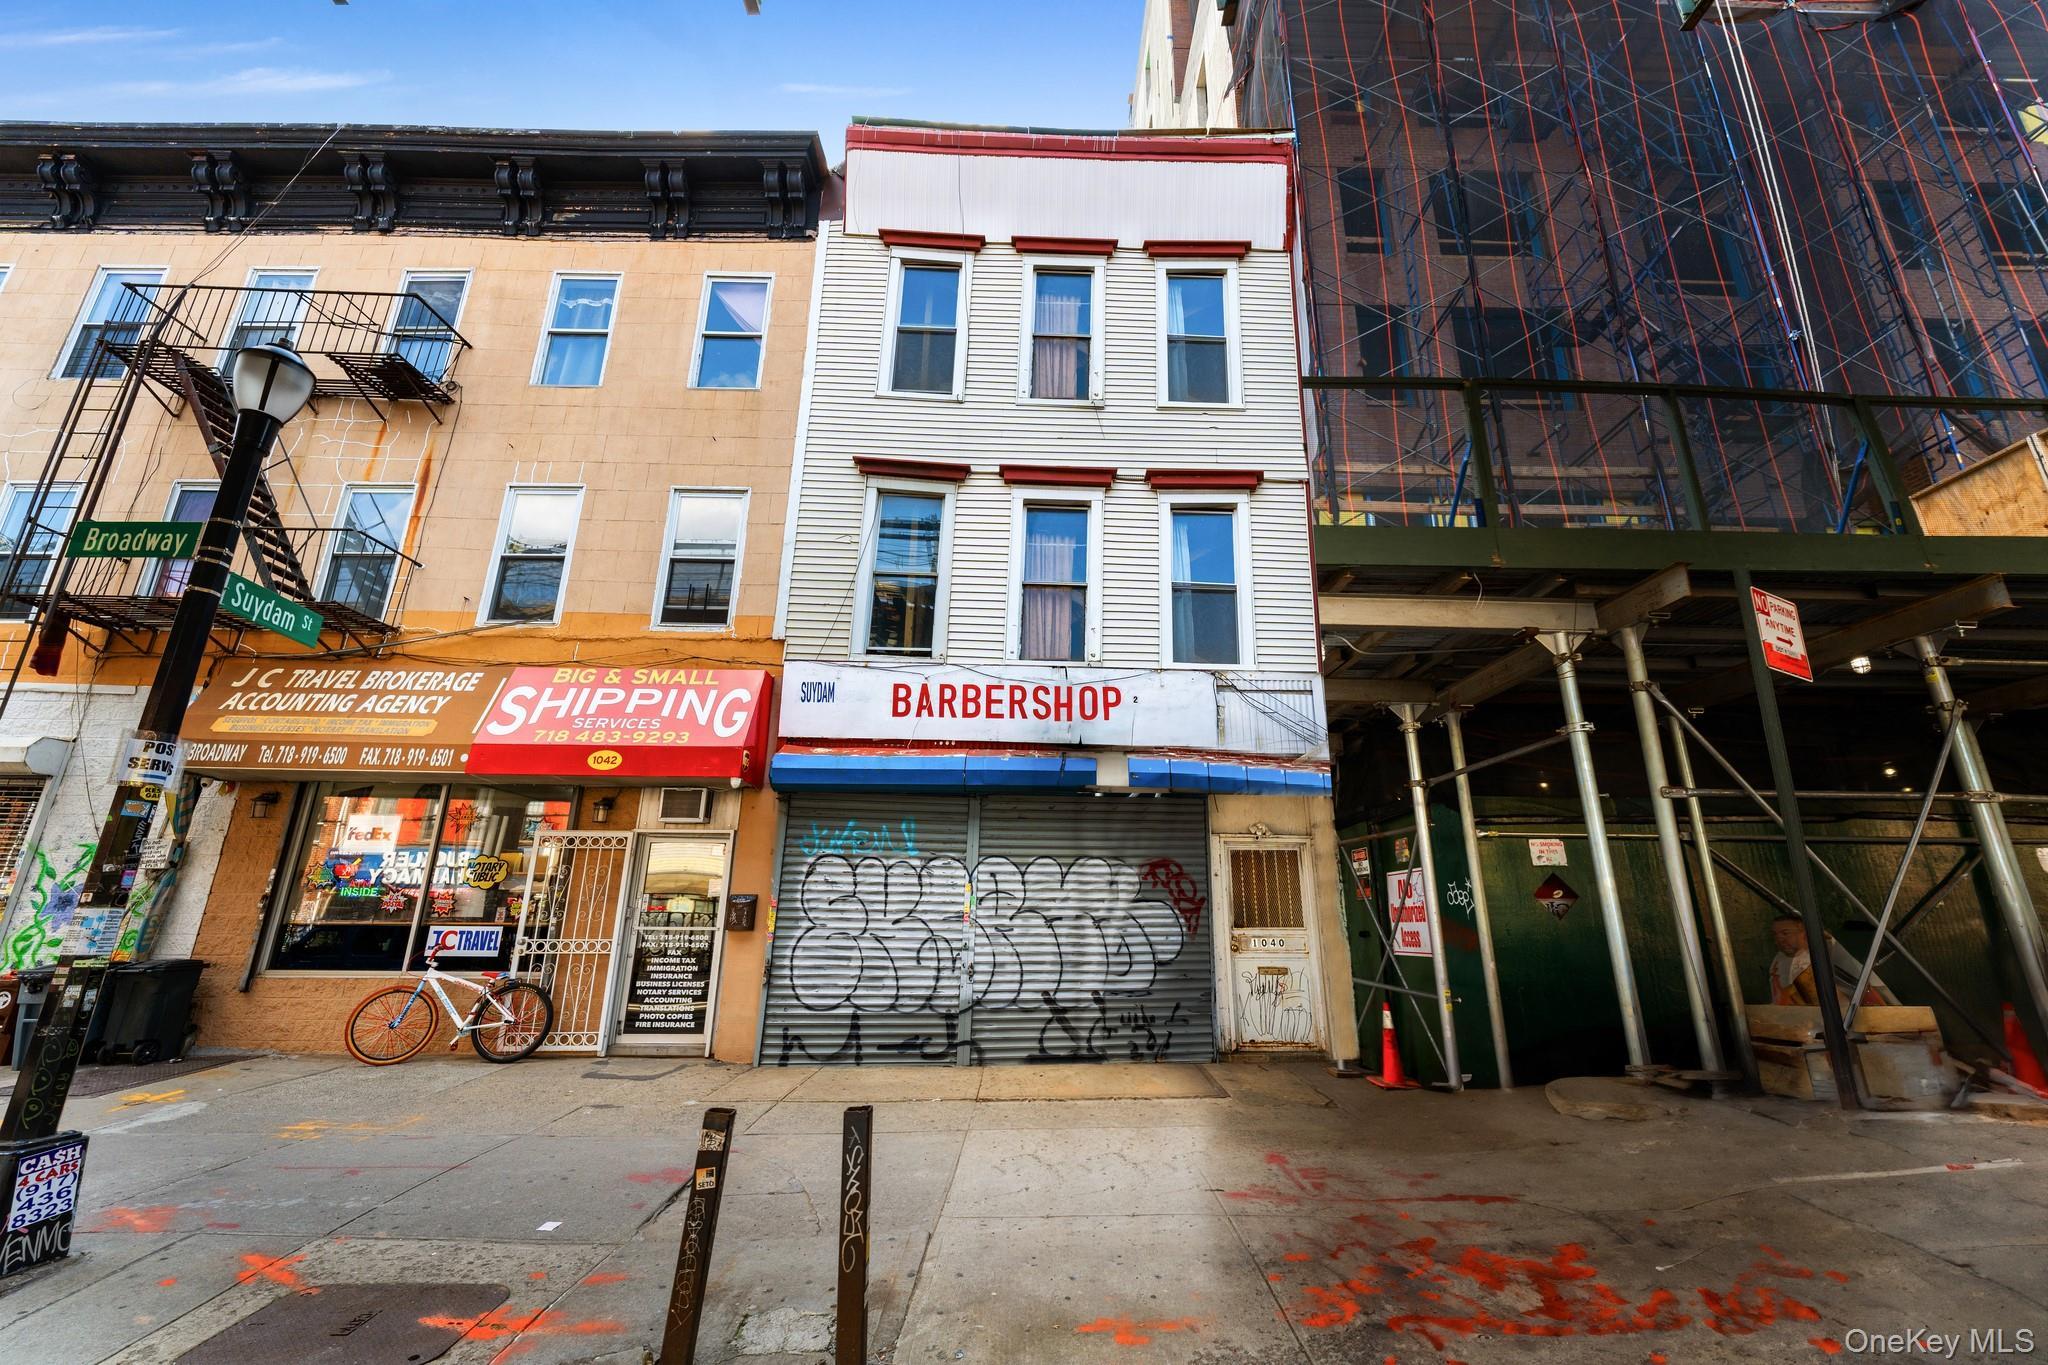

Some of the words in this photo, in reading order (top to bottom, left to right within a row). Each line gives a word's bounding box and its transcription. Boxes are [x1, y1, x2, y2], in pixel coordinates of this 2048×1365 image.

[83, 528, 188, 557] Broadway
[231, 582, 295, 632] Suydam
[302, 615, 313, 631] St
[1754, 592, 1769, 612] NO
[1769, 601, 1796, 620] PARKING
[1765, 619, 1796, 637] ANYTIME
[231, 668, 258, 688] J
[258, 668, 284, 688] C
[284, 669, 362, 690] TRAVEL
[360, 670, 485, 692] BROKERAGE
[552, 668, 597, 685] BIG
[604, 668, 621, 685] &
[630, 669, 720, 686] SMALL
[218, 692, 359, 712] ACCOUNTING
[356, 694, 451, 714] AGENCY
[800, 682, 836, 704] SUYDAM
[891, 682, 1122, 723] BARBERSHOP
[1133, 696, 1139, 704] 2
[486, 685, 752, 738] SHIPPING
[571, 717, 661, 729] SERVICES
[532, 730, 570, 743] 718
[575, 731, 690, 744] 483-9293
[592, 755, 618, 765] 1042
[468, 860, 505, 872] NOTARY
[340, 887, 379, 896] INSIDE
[1252, 939, 1285, 947] 1040
[640, 1004, 695, 1012] TRANSLATIONS
[17, 1175, 30, 1189] 4
[35, 1159, 79, 1183] CARS
[15, 1171, 78, 1202] (917)
[17, 1185, 73, 1213] 436
[11, 1197, 73, 1229] 8323
